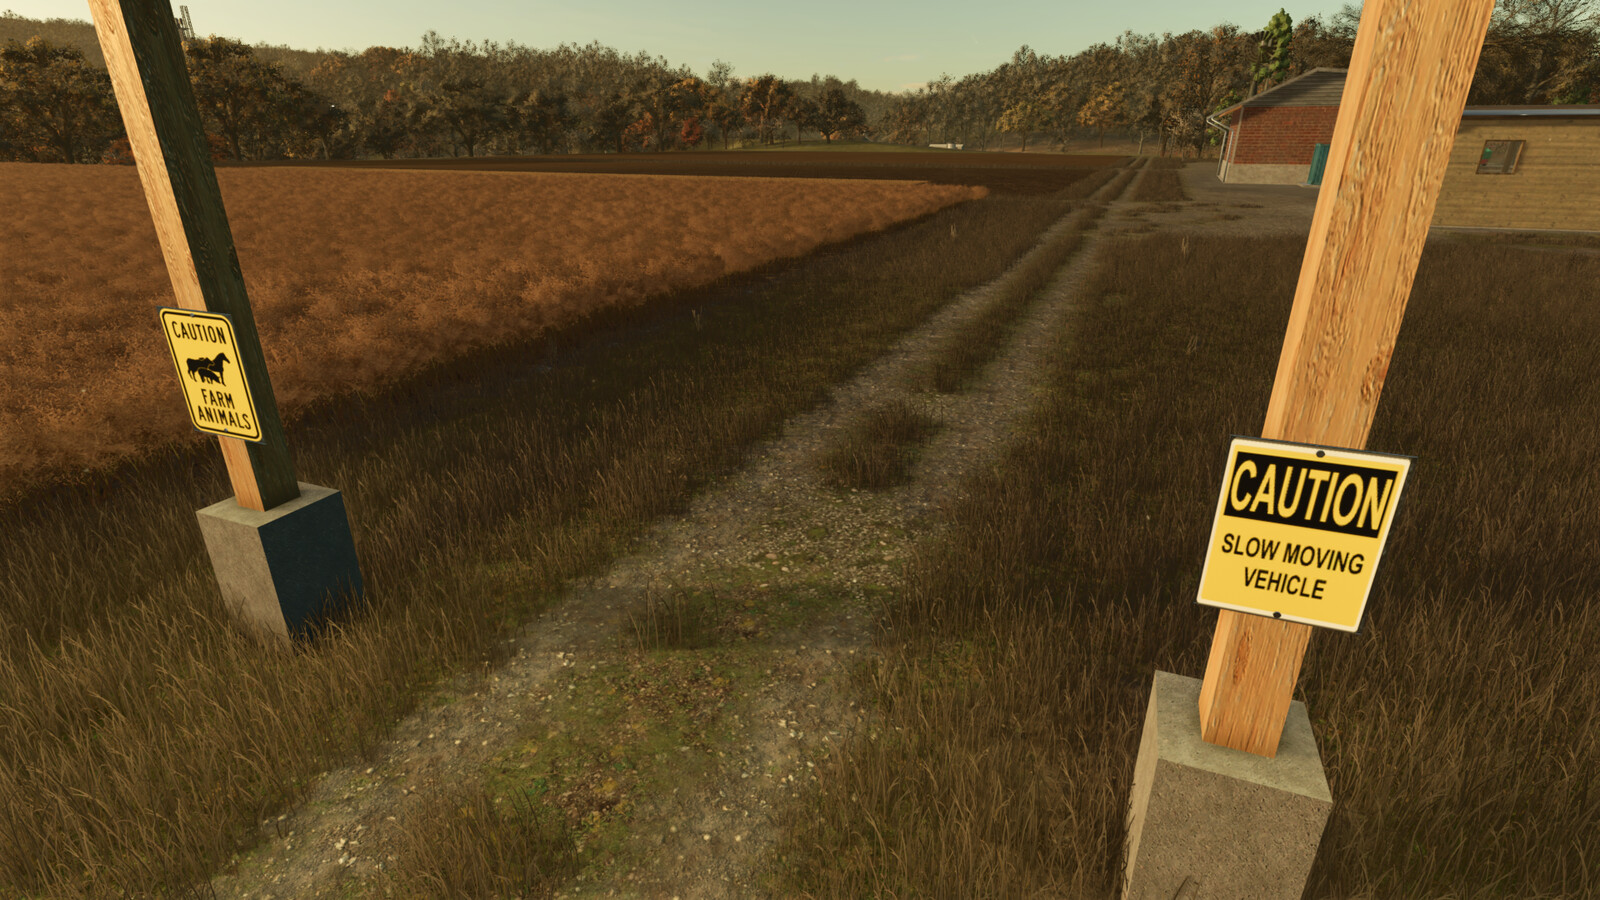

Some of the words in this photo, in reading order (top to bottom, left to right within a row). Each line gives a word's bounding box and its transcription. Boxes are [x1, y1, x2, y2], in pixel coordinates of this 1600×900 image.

[172, 321, 227, 345] CAUTION
[201, 388, 235, 409] FARM
[198, 405, 251, 430] ANIMALS
[1230, 460, 1393, 531] CAUTION
[1221, 533, 1280, 561] SLOW
[1282, 543, 1365, 575] MOVING
[1244, 567, 1327, 600] VEHICLE
